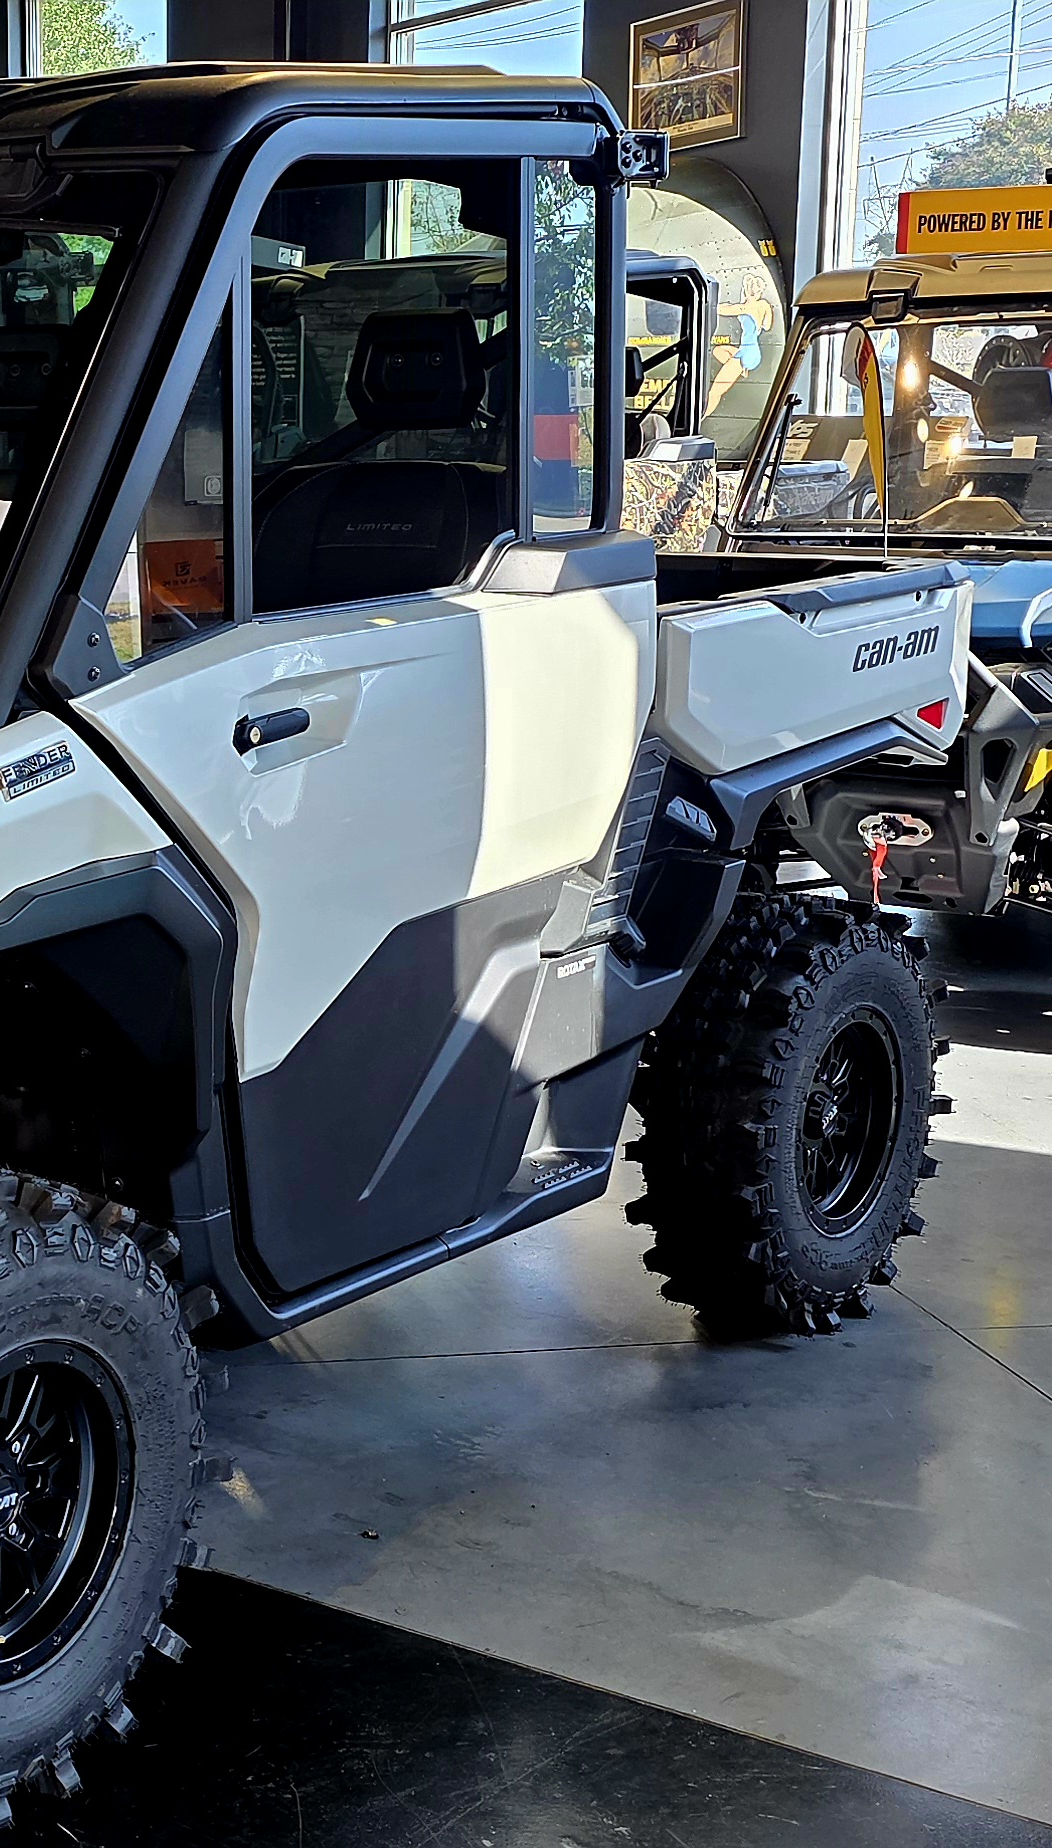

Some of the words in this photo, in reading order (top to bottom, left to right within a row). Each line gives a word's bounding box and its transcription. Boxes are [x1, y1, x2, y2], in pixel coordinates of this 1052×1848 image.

[917, 213, 987, 234] POWERED
[991, 211, 1012, 231] BY
[1016, 210, 1044, 230] THE
[346, 523, 413, 531] LIMITED
[852, 625, 940, 673] can-am
[13, 764, 70, 794] LIMITED
